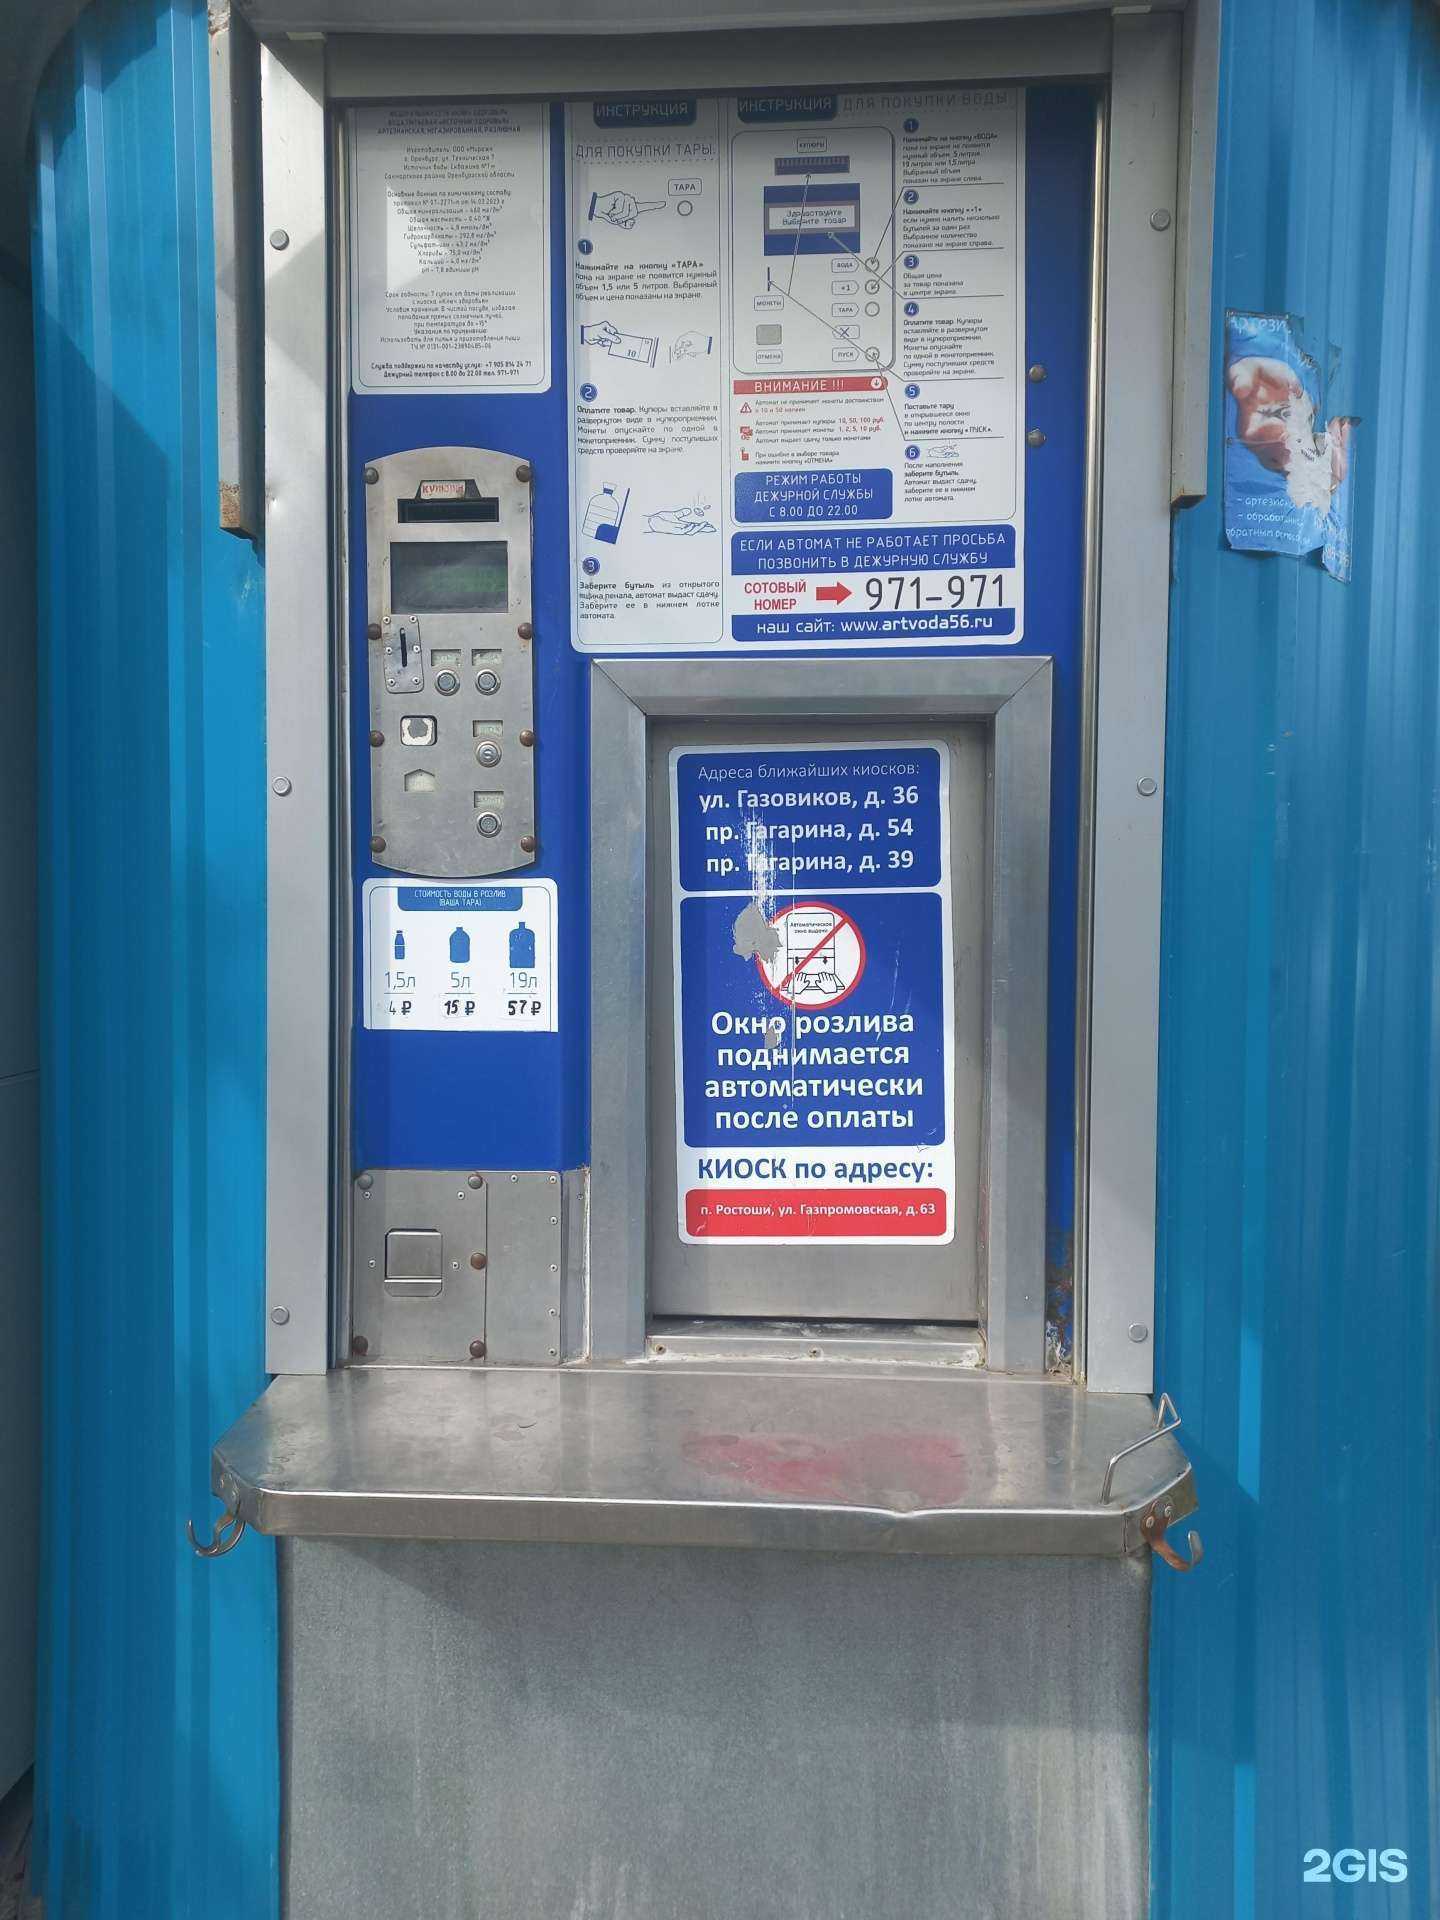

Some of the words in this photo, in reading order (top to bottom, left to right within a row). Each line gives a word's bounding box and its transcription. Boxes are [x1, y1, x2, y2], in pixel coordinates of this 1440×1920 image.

[596, 103, 688, 117] ИНСТРУКЦИЯ
[738, 97, 832, 112] ИНСТРУКЦИЯ
[575, 146, 602, 159] ДЛЯ
[608, 145, 672, 157] ПОКУПКИ
[576, 263, 618, 271] Нажимайте
[640, 262, 668, 271] кнопку
[755, 381, 827, 392] ВНИМАНИЕ
[766, 474, 810, 486] РЕЖИМ
[813, 473, 861, 484] РАБОТЫ
[755, 487, 821, 503] ДЕЖУРНОЙ
[823, 488, 873, 501] СЛУЖБЫ
[770, 507, 775, 517] С
[779, 506, 803, 517] 8.00
[806, 506, 823, 517] ДО
[827, 505, 857, 516] 22.00
[740, 539, 774, 551] ЕСЛИ
[777, 537, 841, 550] АВТОМАТ
[846, 536, 862, 548] НЕ
[867, 534, 938, 547] РАБОТАЕТ
[943, 533, 1005, 545] ПРОСЬБА
[758, 556, 837, 570] ПОЗВОНИТЬ
[841, 556, 849, 567] В
[854, 554, 929, 569] ДЕЖУРНУЮ
[933, 552, 987, 565] СЛУЖБУ
[625, 582, 654, 590] бутыль
[744, 580, 806, 594] СОТОВЫЙ
[866, 574, 1003, 611] 971-971
[754, 599, 796, 611] НОМЕР
[757, 620, 789, 633] наш
[796, 618, 835, 633] сайт:
[841, 614, 992, 632] www.artvoda56.ru
[698, 766, 753, 783] Адреса
[758, 764, 847, 778] ближайших
[852, 763, 919, 776] киосков:
[699, 793, 729, 812] ул.
[738, 789, 858, 809] Газовиков,
[864, 791, 885, 808] д.
[893, 786, 919, 804] 36
[706, 826, 738, 844] пр.
[747, 822, 852, 841] Гагарина,
[858, 823, 880, 840] д.
[887, 818, 914, 836] 54
[707, 858, 739, 876] пр.
[747, 854, 852, 874] Гагарина,
[859, 856, 881, 873] д.
[888, 851, 914, 868] 39
[414, 890, 451, 898] СТОИМОСТЬ
[454, 890, 471, 898] ВОДЫ
[481, 890, 506, 898] РОЗЛИВ
[385, 972, 415, 990] 1,5л
[451, 972, 470, 988] 5л
[510, 972, 537, 988] 19л
[389, 1001, 396, 1015] 4
[444, 1000, 459, 1015] 15
[508, 1000, 526, 1016] 57
[711, 1012, 786, 1035] Окно
[796, 1012, 914, 1038] розлива
[718, 1046, 909, 1071] поднимается
[705, 1078, 922, 1097] автоматически
[716, 1112, 797, 1129] после
[807, 1110, 914, 1128] оплаты
[698, 1159, 787, 1179] КИОСК
[796, 1162, 826, 1178] по
[835, 1161, 933, 1183] адресу:
[701, 1206, 712, 1215] п.
[716, 1205, 774, 1217] Ростоши,
[779, 1206, 795, 1217] ул.
[800, 1204, 902, 1216] Газпромовская,
